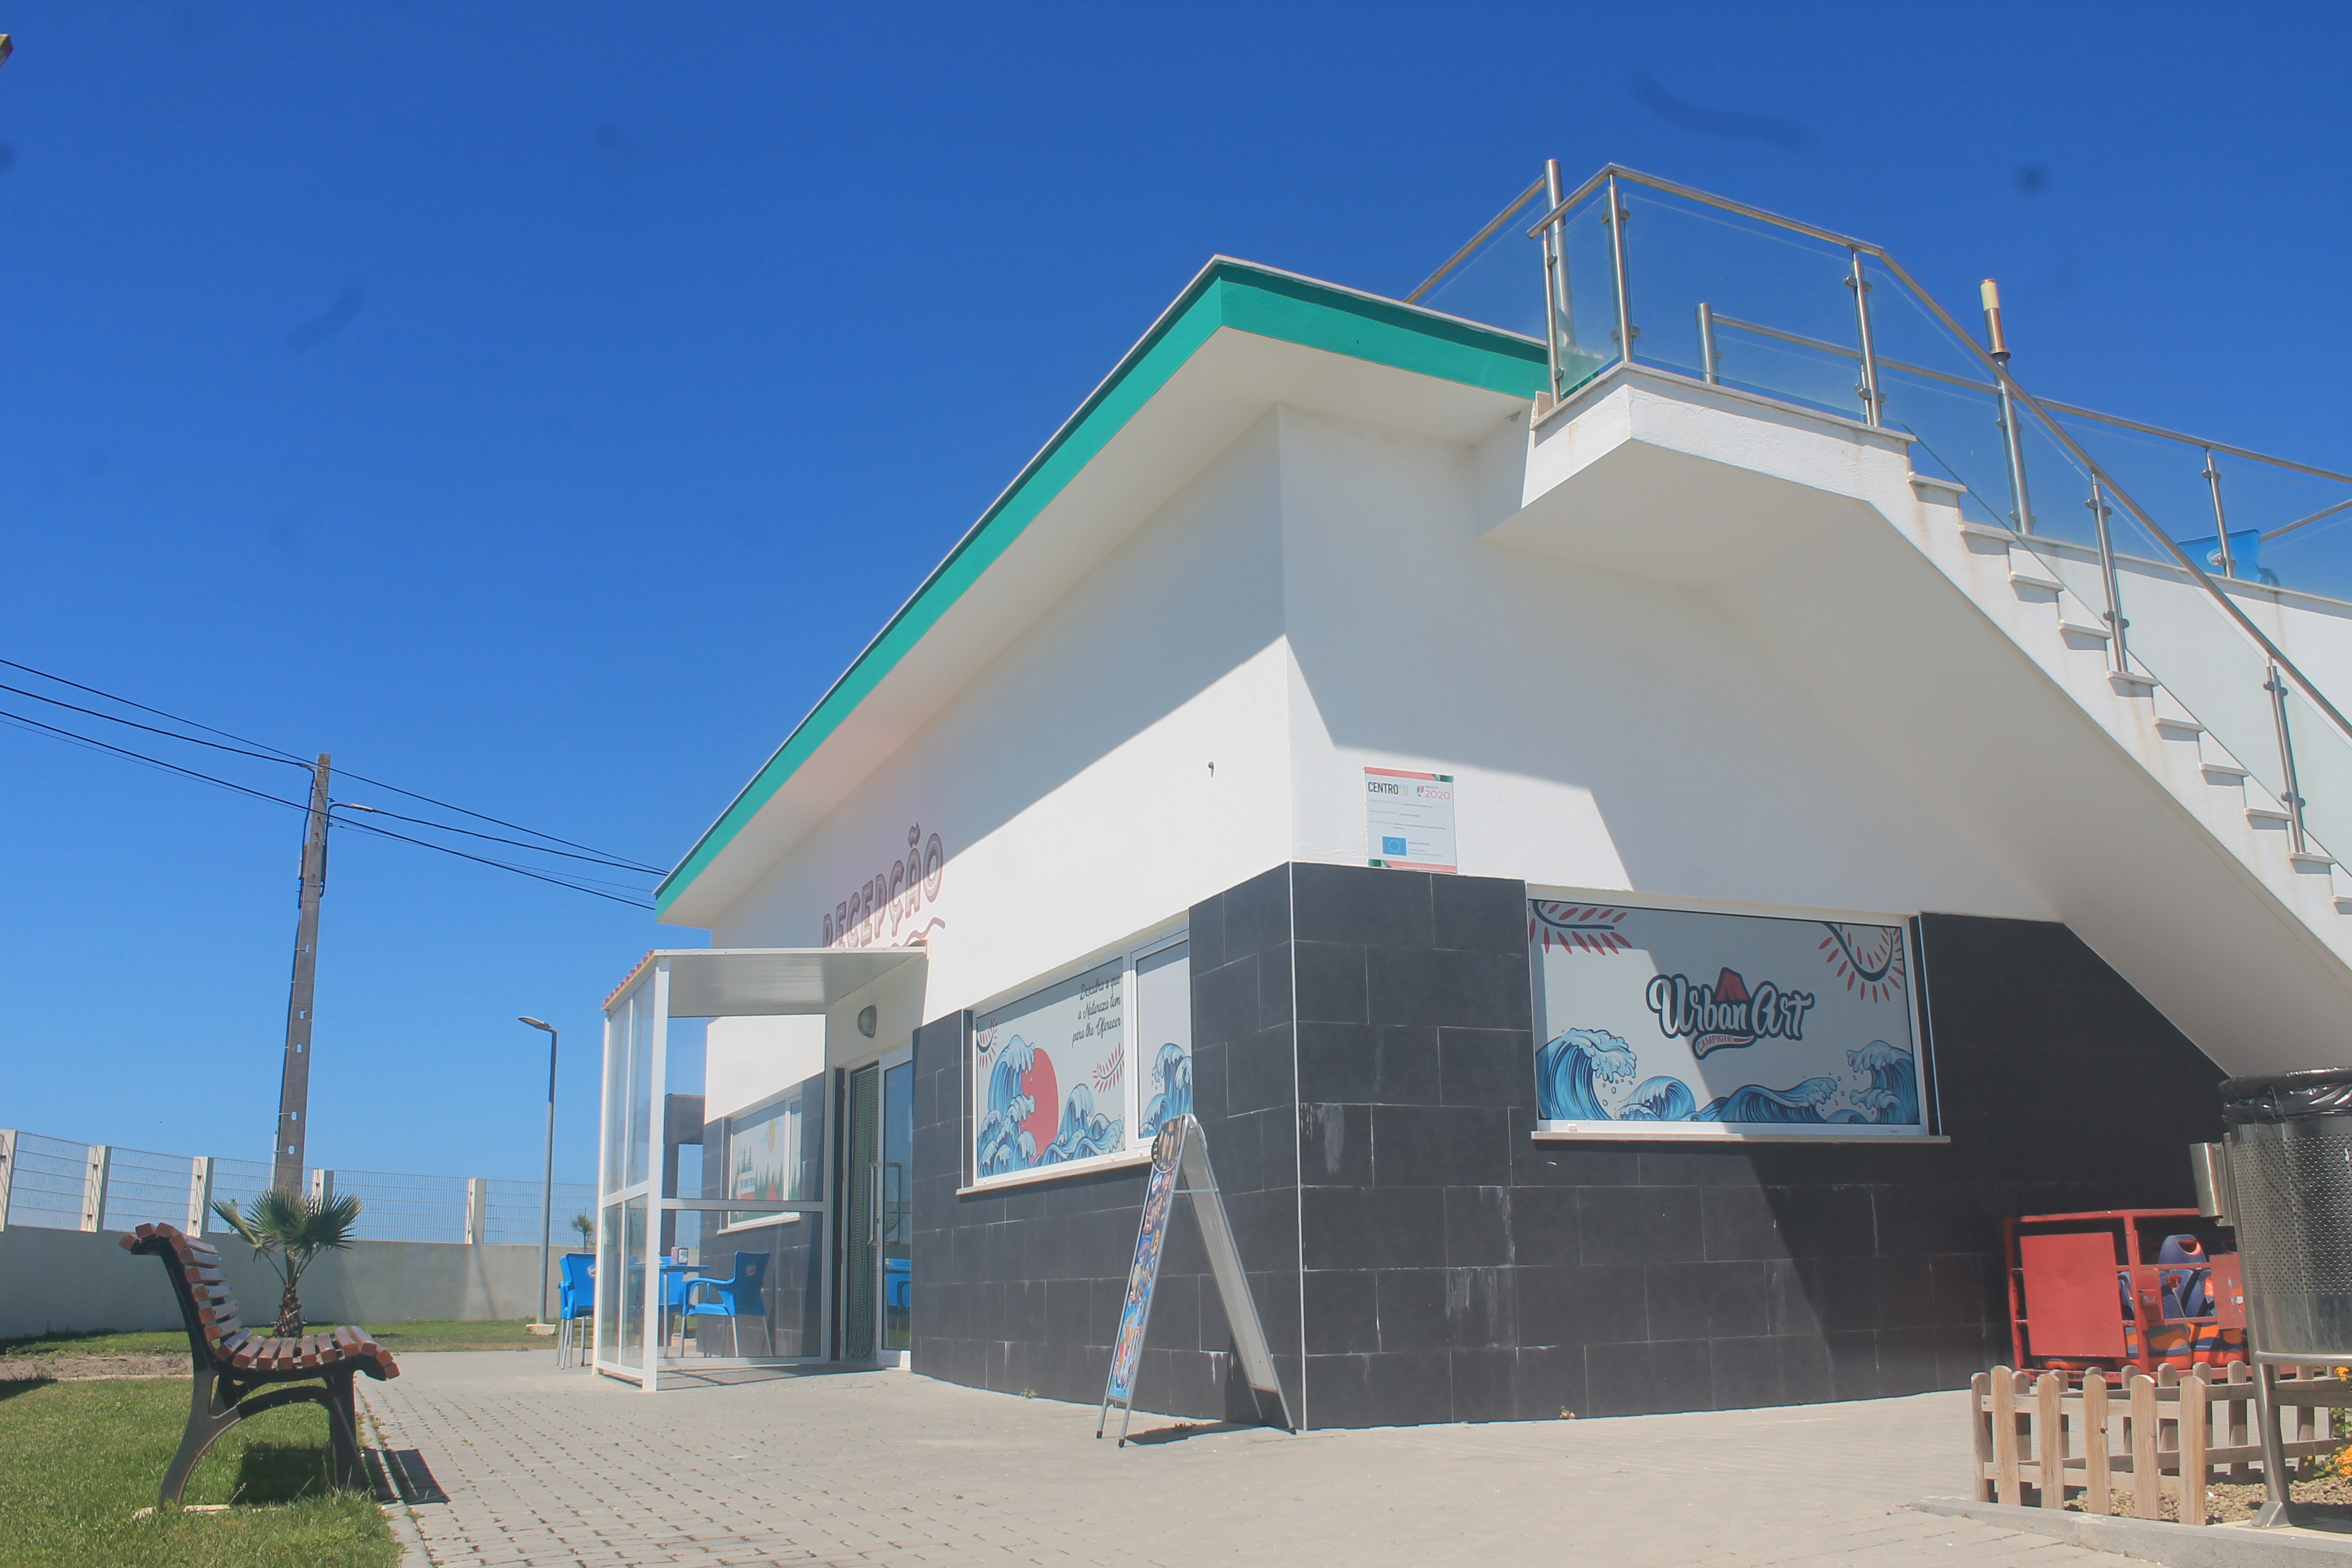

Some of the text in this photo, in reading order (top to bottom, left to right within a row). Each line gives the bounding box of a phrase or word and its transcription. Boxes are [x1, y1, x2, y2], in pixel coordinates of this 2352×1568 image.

[1368, 781, 1399, 795] CENTRO
[1425, 790, 1451, 800] 2020
[1080, 978, 1104, 1000] Descubra
[1110, 975, 1120, 994] que
[1077, 993, 1121, 1020] a Natureza tem
[1646, 974, 1814, 1039] Urban Art
[1071, 1017, 1121, 1048] para lhe Oferecer
[1697, 1035, 1733, 1052] CAMPIGIR
